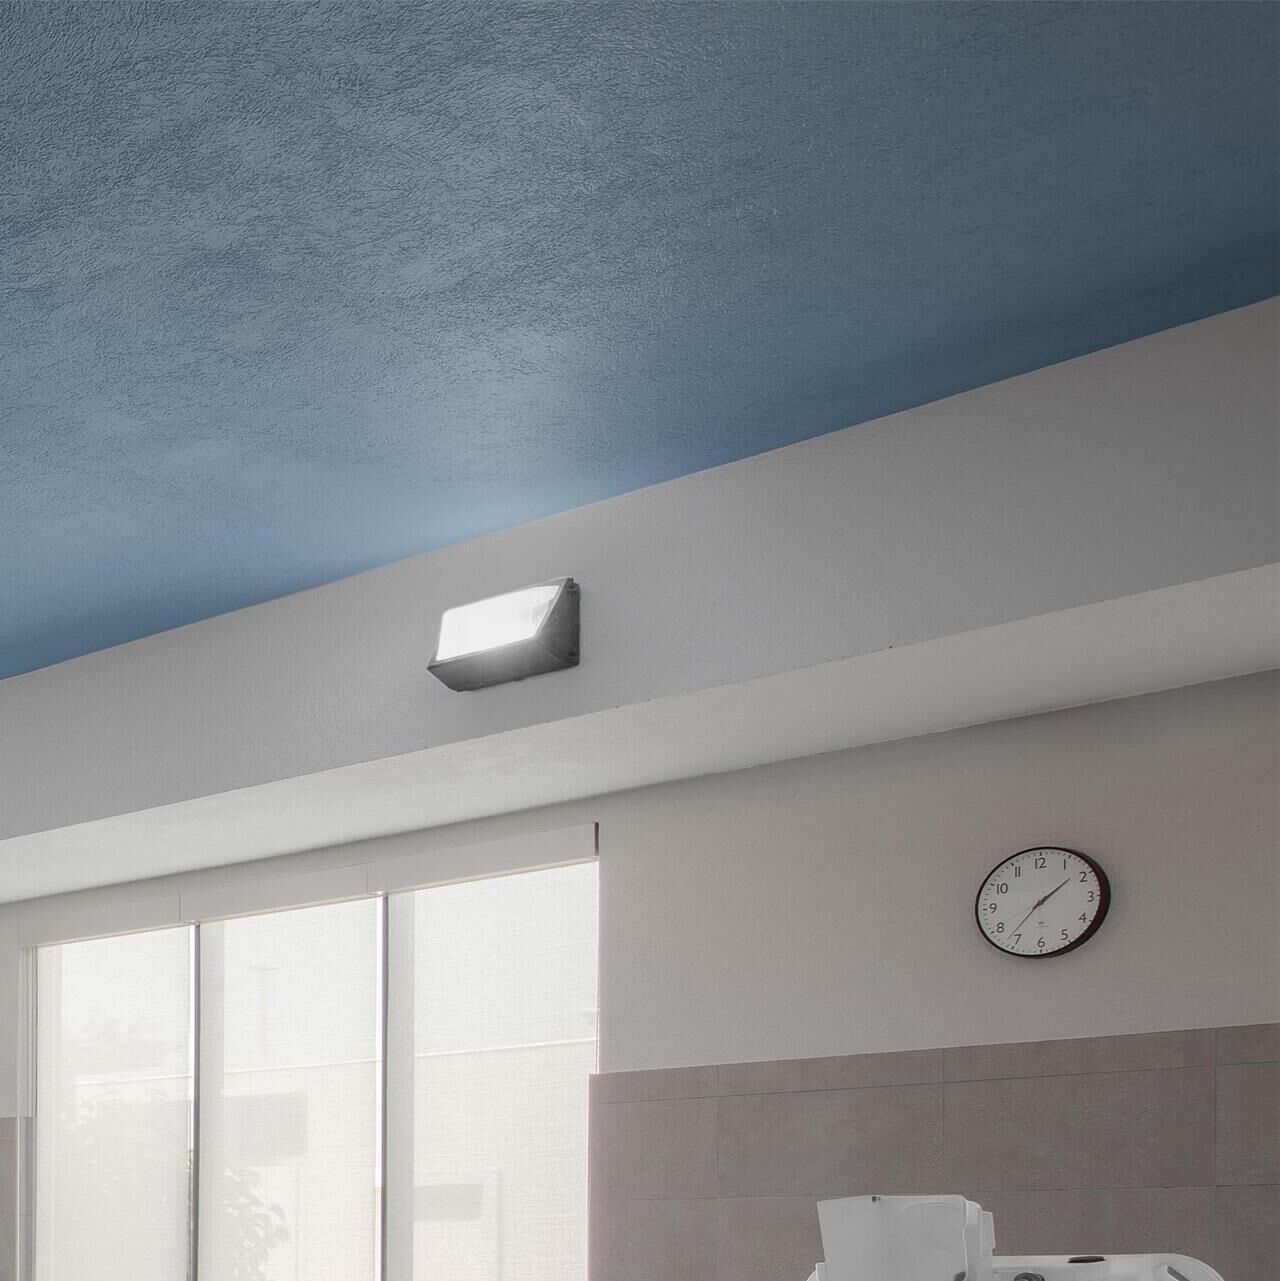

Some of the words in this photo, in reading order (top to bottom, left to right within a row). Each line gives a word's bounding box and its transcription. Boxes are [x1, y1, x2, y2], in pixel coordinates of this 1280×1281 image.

[1034, 857, 1047, 870] 12
[1014, 866, 1021, 878] 11
[1079, 871, 1088, 883] 2
[996, 882, 1008, 895] 10
[1087, 891, 1095, 903] 3
[989, 902, 998, 914] 9
[1078, 912, 1087, 923] 4
[996, 922, 1005, 934] 8
[1014, 933, 1022, 945] 7
[1060, 928, 1069, 941] 5
[1037, 936, 1046, 948] 6
